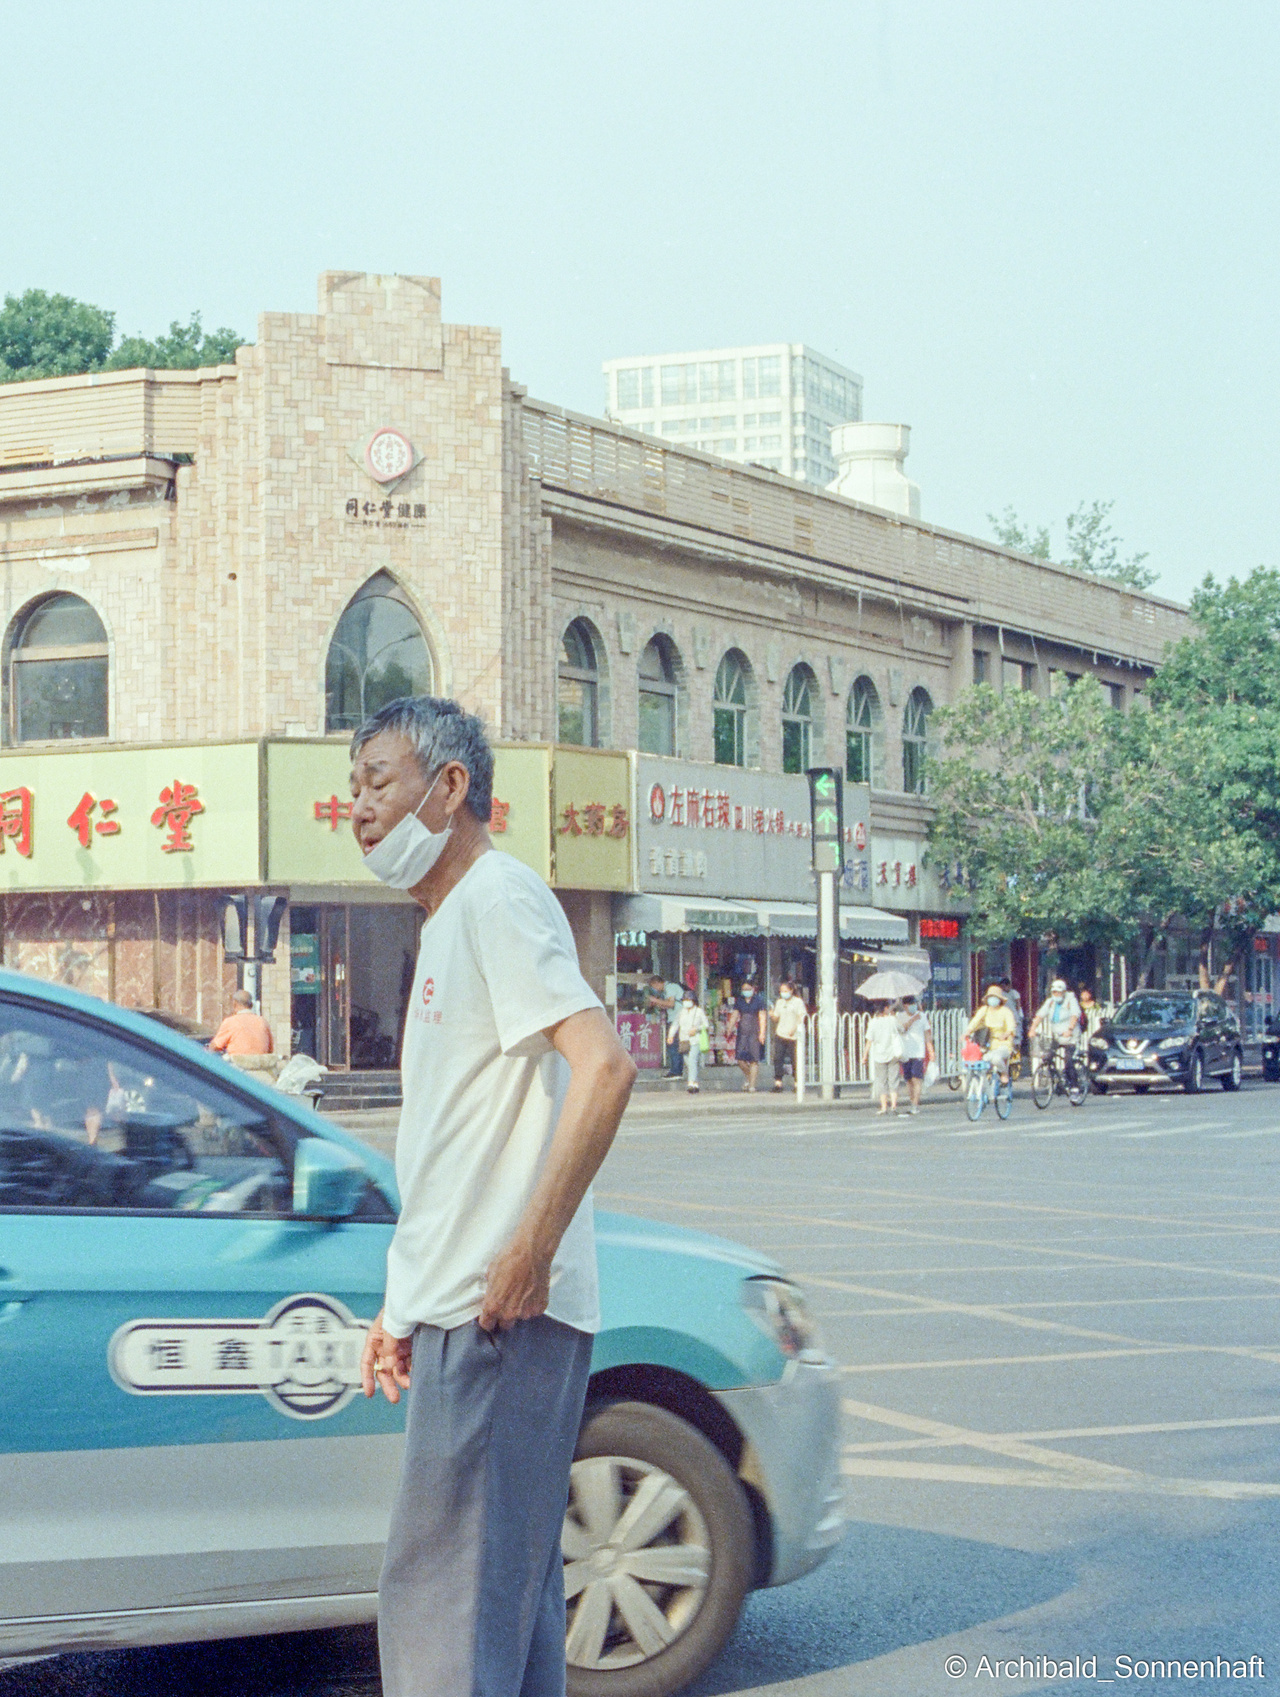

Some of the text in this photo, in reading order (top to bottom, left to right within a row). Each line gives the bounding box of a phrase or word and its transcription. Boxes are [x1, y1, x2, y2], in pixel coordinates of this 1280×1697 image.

[559, 802, 629, 839] 大药房
[669, 784, 730, 828] 左麻右辣
